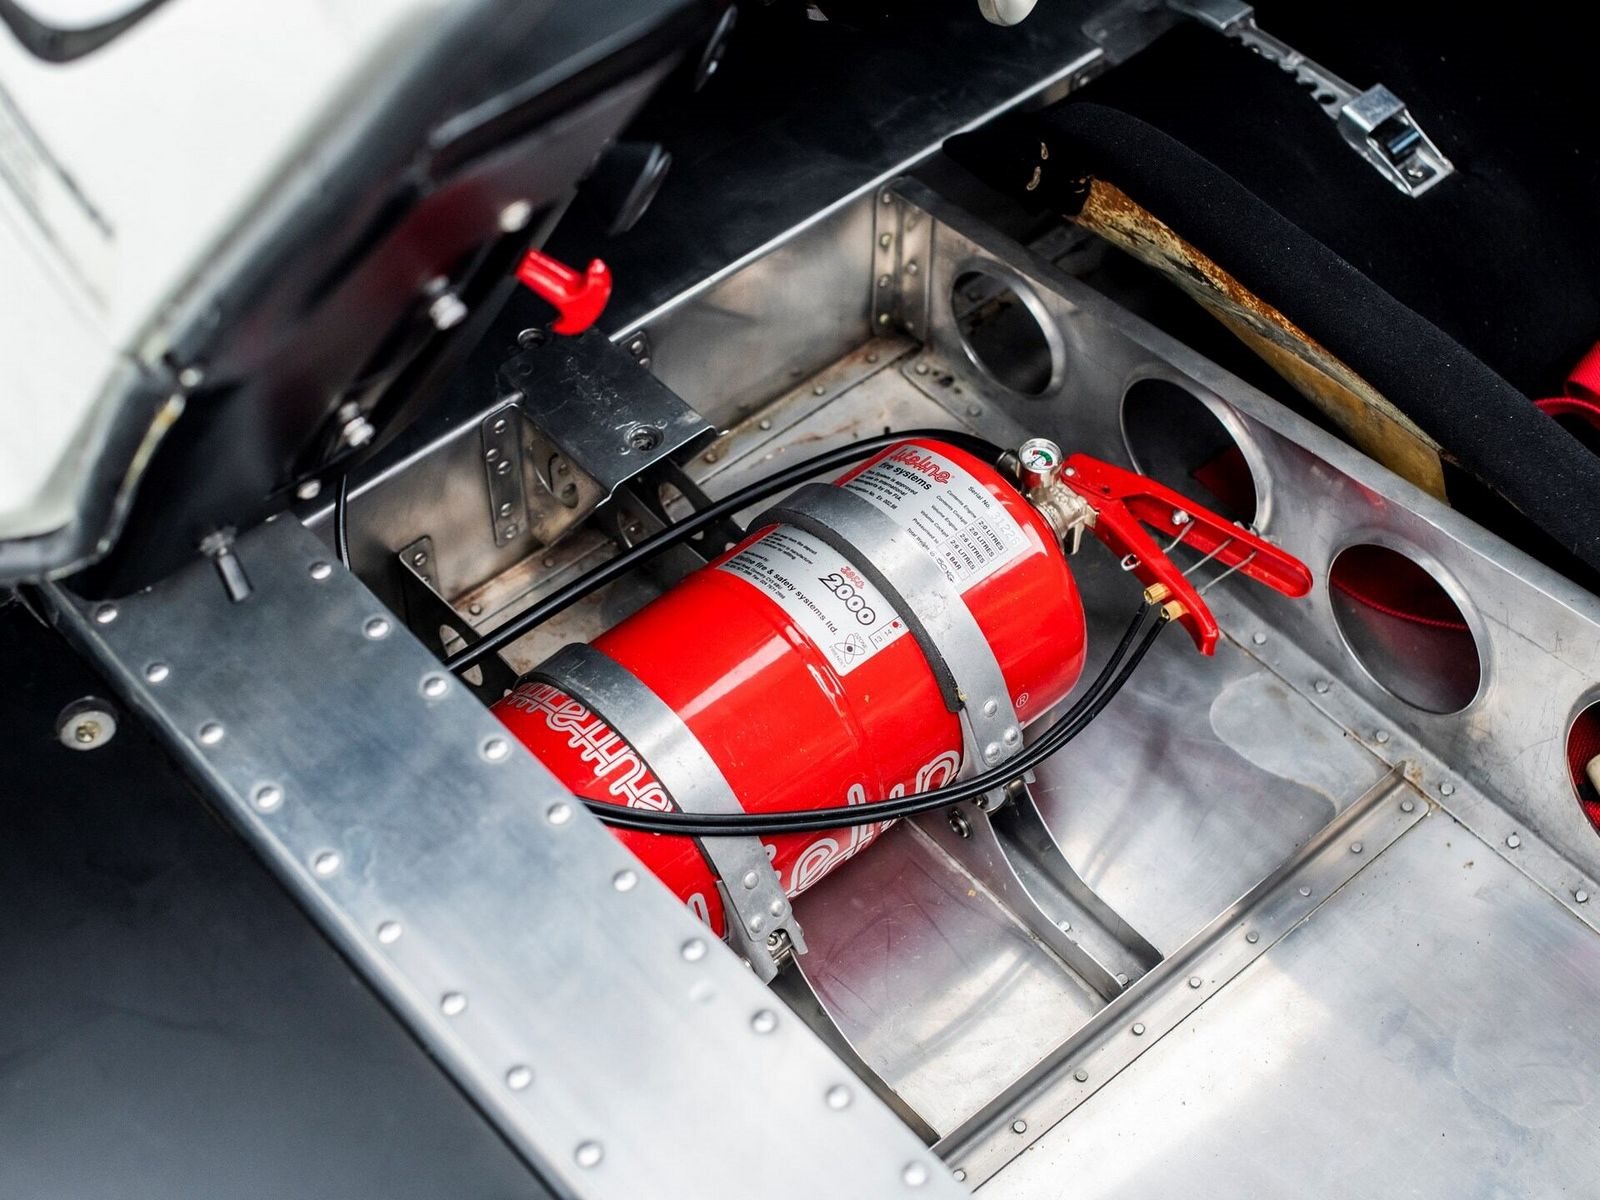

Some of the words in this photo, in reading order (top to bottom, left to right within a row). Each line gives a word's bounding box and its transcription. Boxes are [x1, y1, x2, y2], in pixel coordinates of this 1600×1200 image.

[893, 467, 932, 491] systems
[968, 486, 982, 501] Serial
[976, 535, 995, 558] LITRES
[985, 529, 1004, 551] LITRES
[949, 555, 962, 570] BAR
[957, 546, 976, 570] LITRES
[967, 541, 986, 564] LITRES
[755, 562, 768, 571] fire
[773, 574, 797, 593] safety
[795, 591, 826, 621] systems
[825, 620, 838, 635] ltd.
[817, 573, 876, 626] 2000
